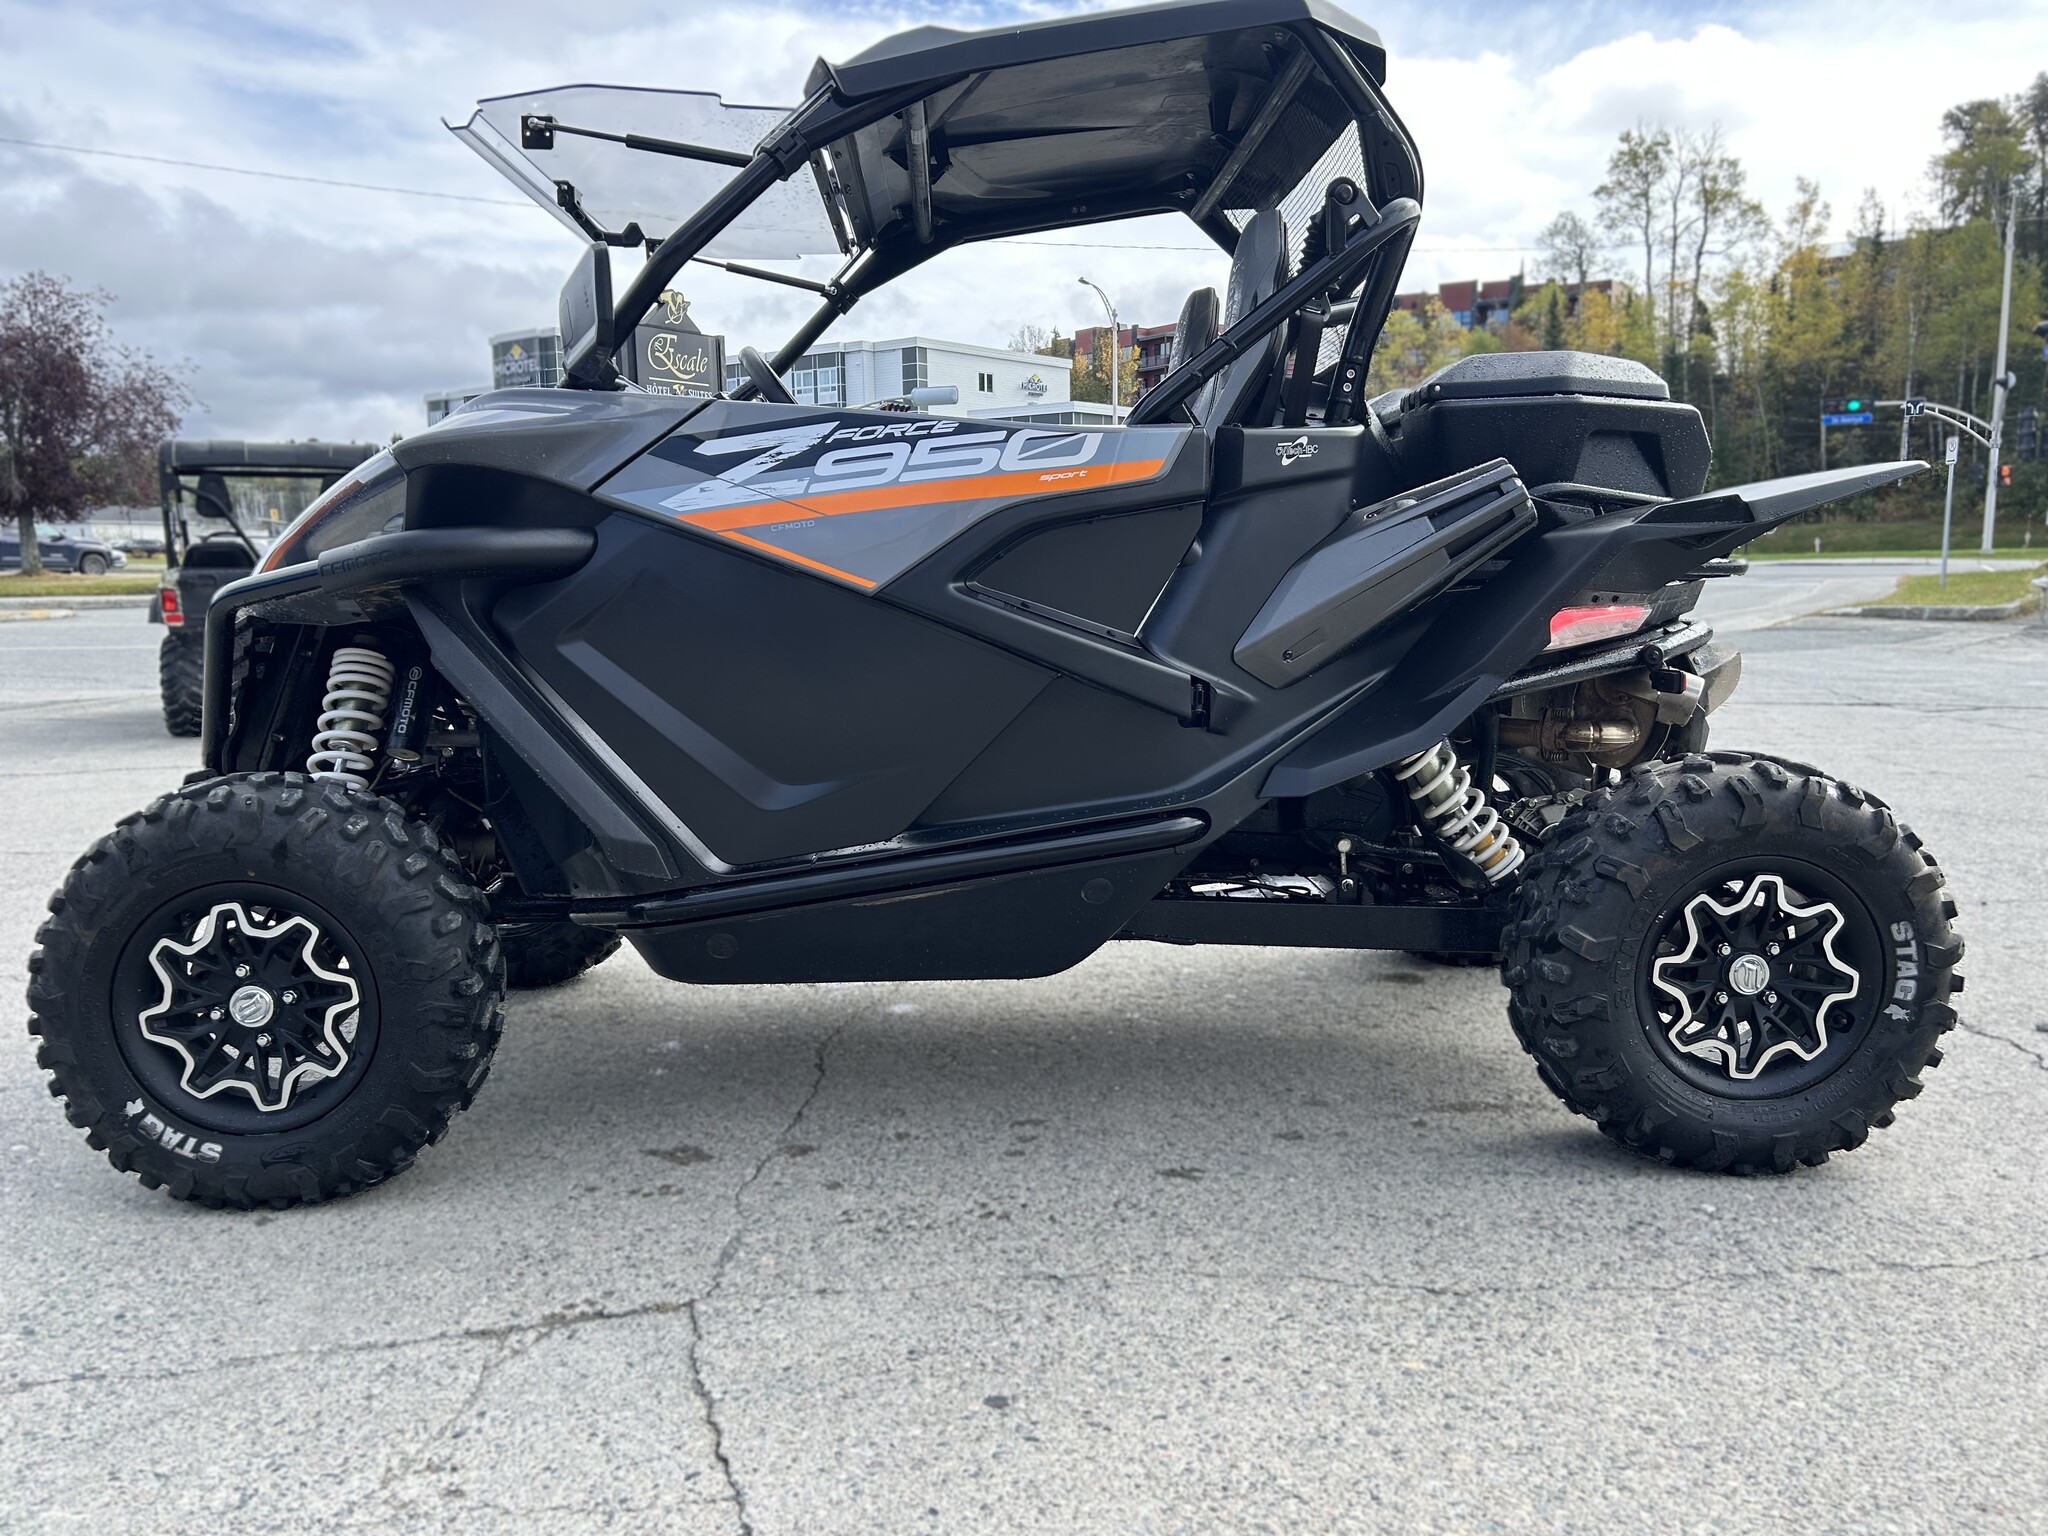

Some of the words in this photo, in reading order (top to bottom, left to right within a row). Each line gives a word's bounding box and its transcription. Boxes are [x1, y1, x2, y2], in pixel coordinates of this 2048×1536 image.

[825, 420, 960, 444] FORCE
[1038, 469, 1088, 482] sport
[770, 520, 815, 532] CFMOTO
[397, 680, 417, 734] CFMOTO
[1890, 920, 1919, 1002] STAG
[137, 1112, 223, 1164] STAG
